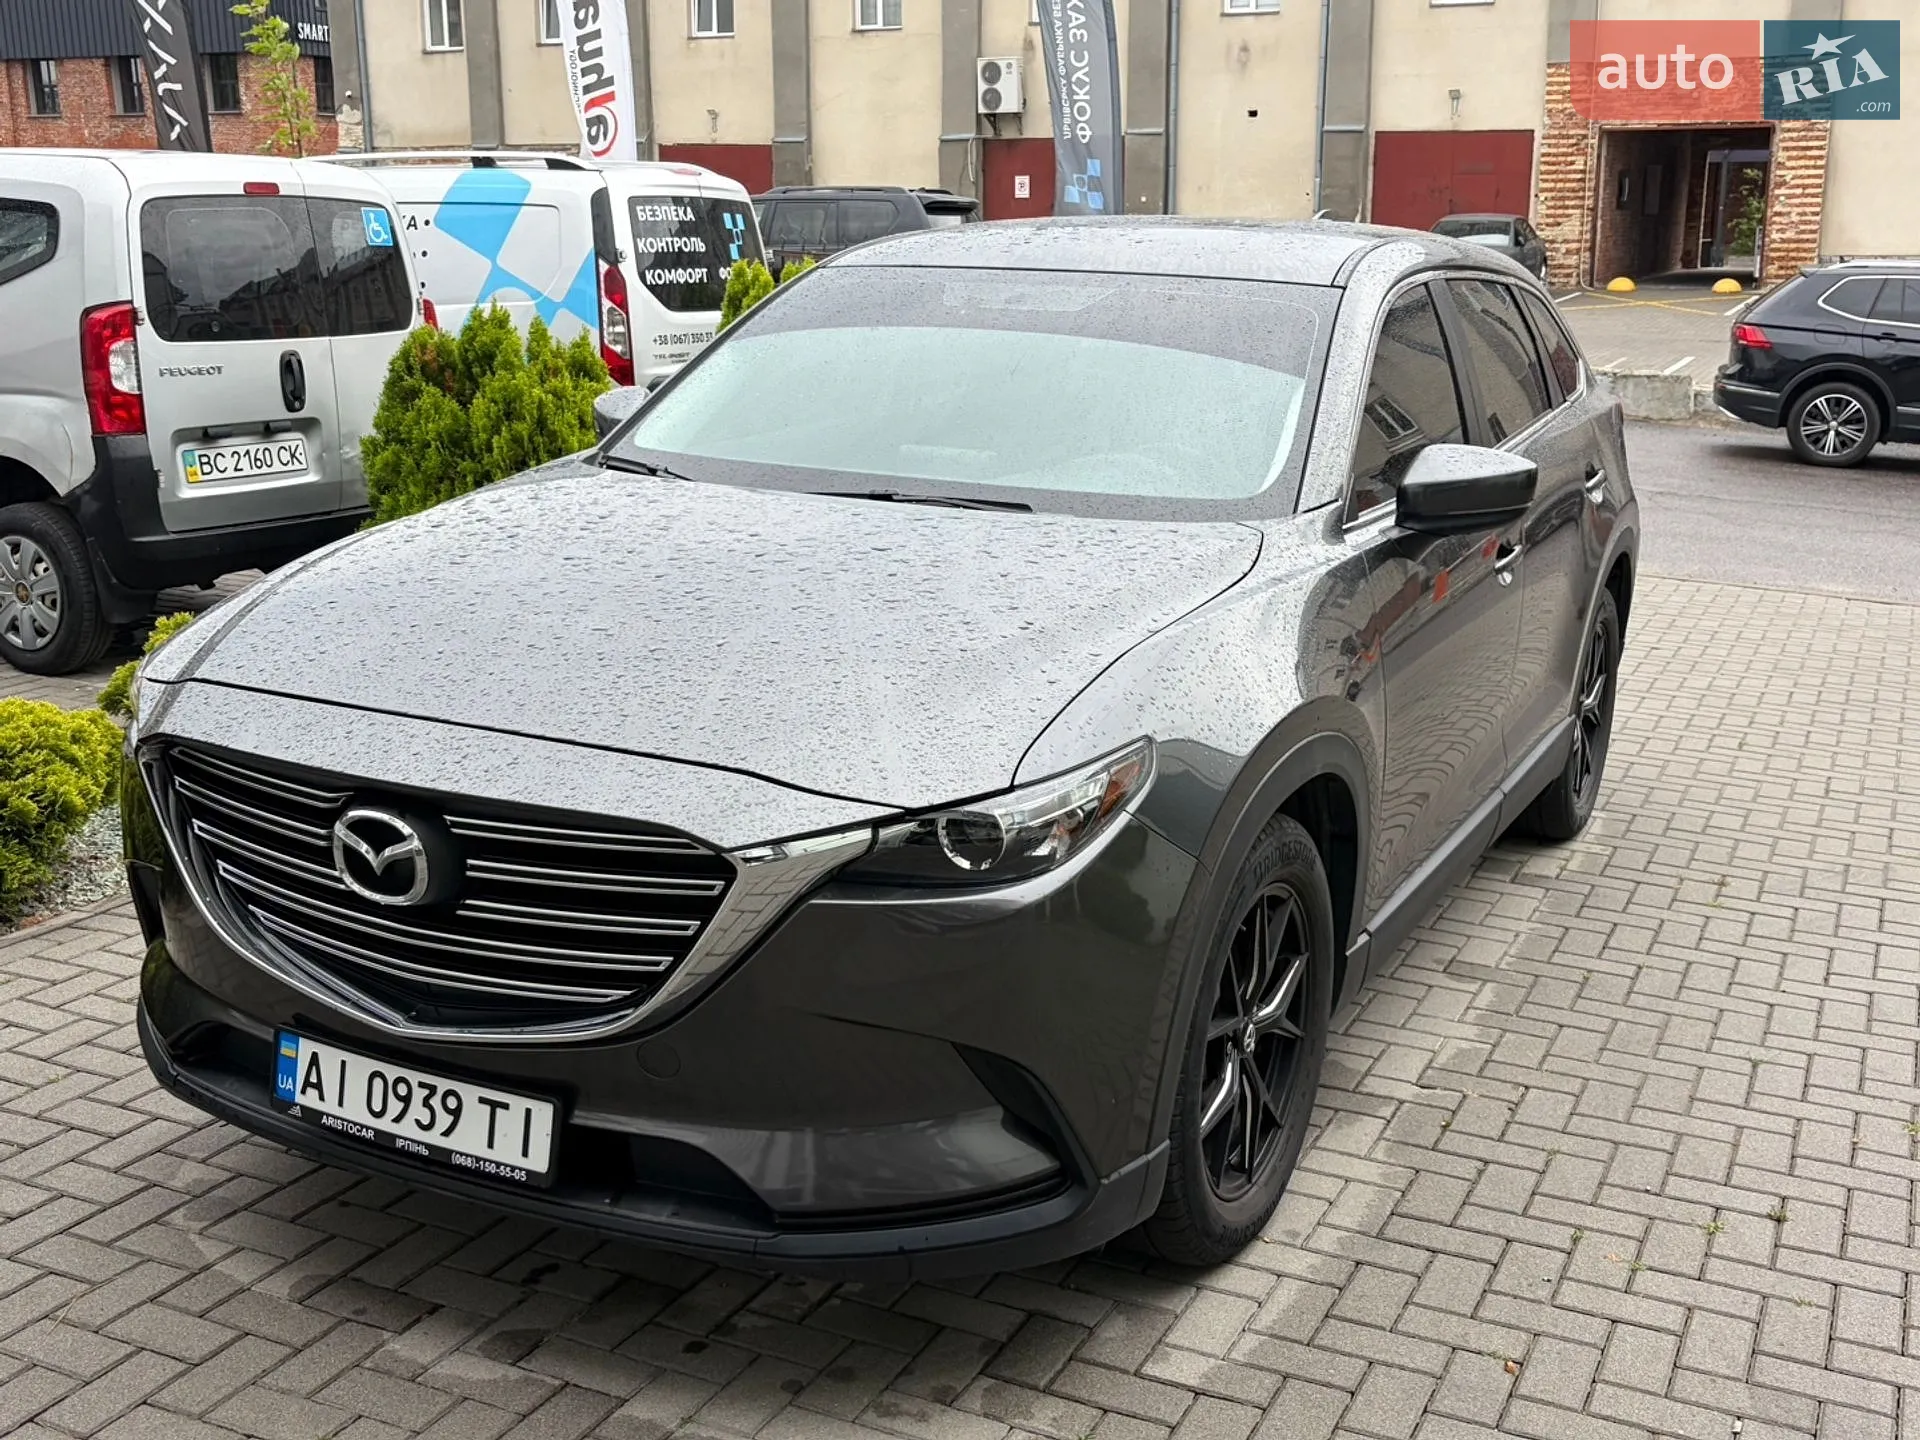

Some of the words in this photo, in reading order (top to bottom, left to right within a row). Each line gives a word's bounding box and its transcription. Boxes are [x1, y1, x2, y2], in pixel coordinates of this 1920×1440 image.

[297, 22, 329, 42] SMART
[636, 206, 695, 221] БЕЗПЕКА
[636, 236, 706, 253] КОНТРОЛЬ
[645, 268, 708, 285] КОМФОРТ
[159, 365, 224, 377] PEUGEOT
[198, 453, 228, 476] BC
[231, 447, 274, 473] 2160
[277, 444, 304, 467] CK
[278, 1074, 294, 1092] UA
[299, 1050, 347, 1109] AI
[366, 1070, 464, 1138] 0939
[478, 1096, 533, 1159] TI
[321, 1114, 375, 1140] ARISTOCAR
[395, 1137, 430, 1156] ІРПІНЬ
[451, 1151, 528, 1182] (068)-150-55-05
